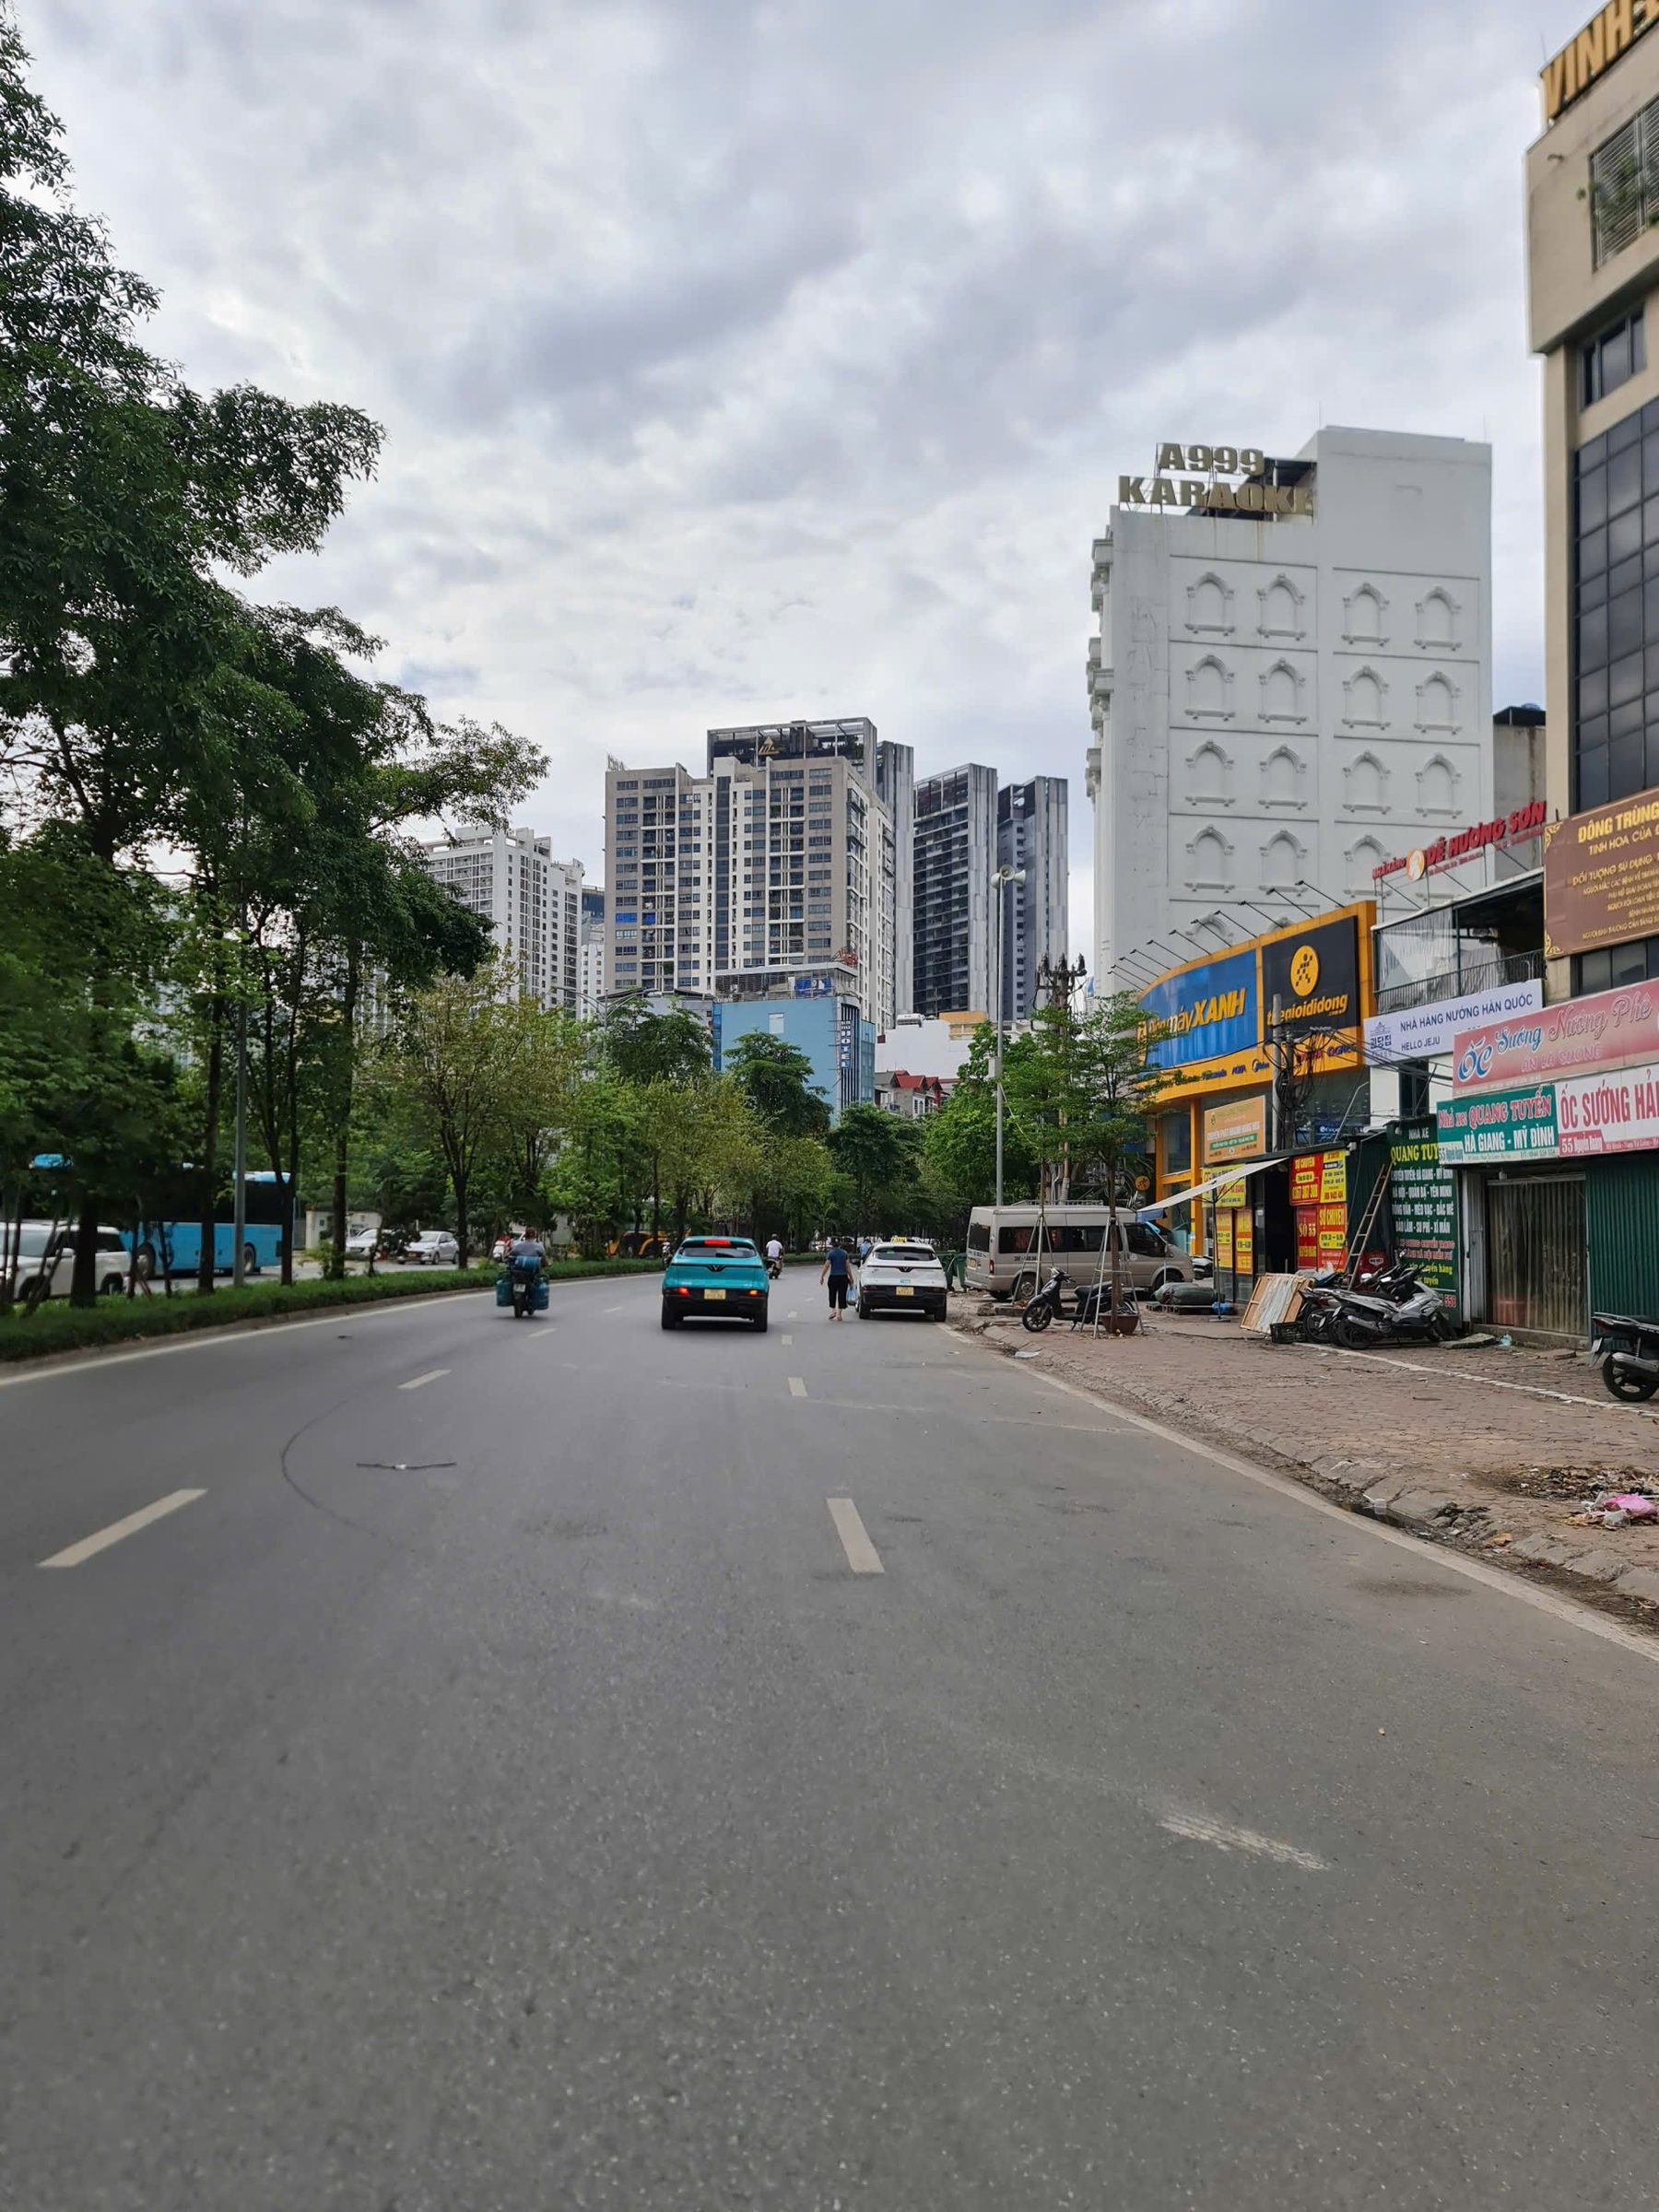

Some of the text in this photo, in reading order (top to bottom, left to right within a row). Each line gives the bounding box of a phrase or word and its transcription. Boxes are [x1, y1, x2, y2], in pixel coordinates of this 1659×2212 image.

[1542, 0, 1634, 120] VINH
[1158, 442, 1265, 477] A999
[1119, 476, 1313, 515] KARAOKE
[1578, 819, 1613, 843] ĐÔNG
[1589, 842, 1607, 856] TINH
[1609, 834, 1630, 850] HOA
[1266, 994, 1348, 1026] tegioididong
[1400, 994, 1534, 1032] NHÀ HÀNG NƯỚNG HÀN QUỐC
[1401, 1036, 1441, 1052] HELLO JEJU
[1468, 1100, 1509, 1130] QUANG
[1560, 1085, 1578, 1130] ỐC
[1583, 1078, 1630, 1127] SƯỚNG
[1408, 1127, 1430, 1140] NHÀ XE
[1465, 1131, 1477, 1153] HÀ
[1477, 1130, 1506, 1152] GIANG
[1512, 1124, 1528, 1149] MỸ
[1530, 1122, 1555, 1147] ĐÌNH
[1562, 1136, 1573, 1153] 55
[1390, 1145, 1419, 1166] QUANG
[1308, 1223, 1316, 1237] 55
